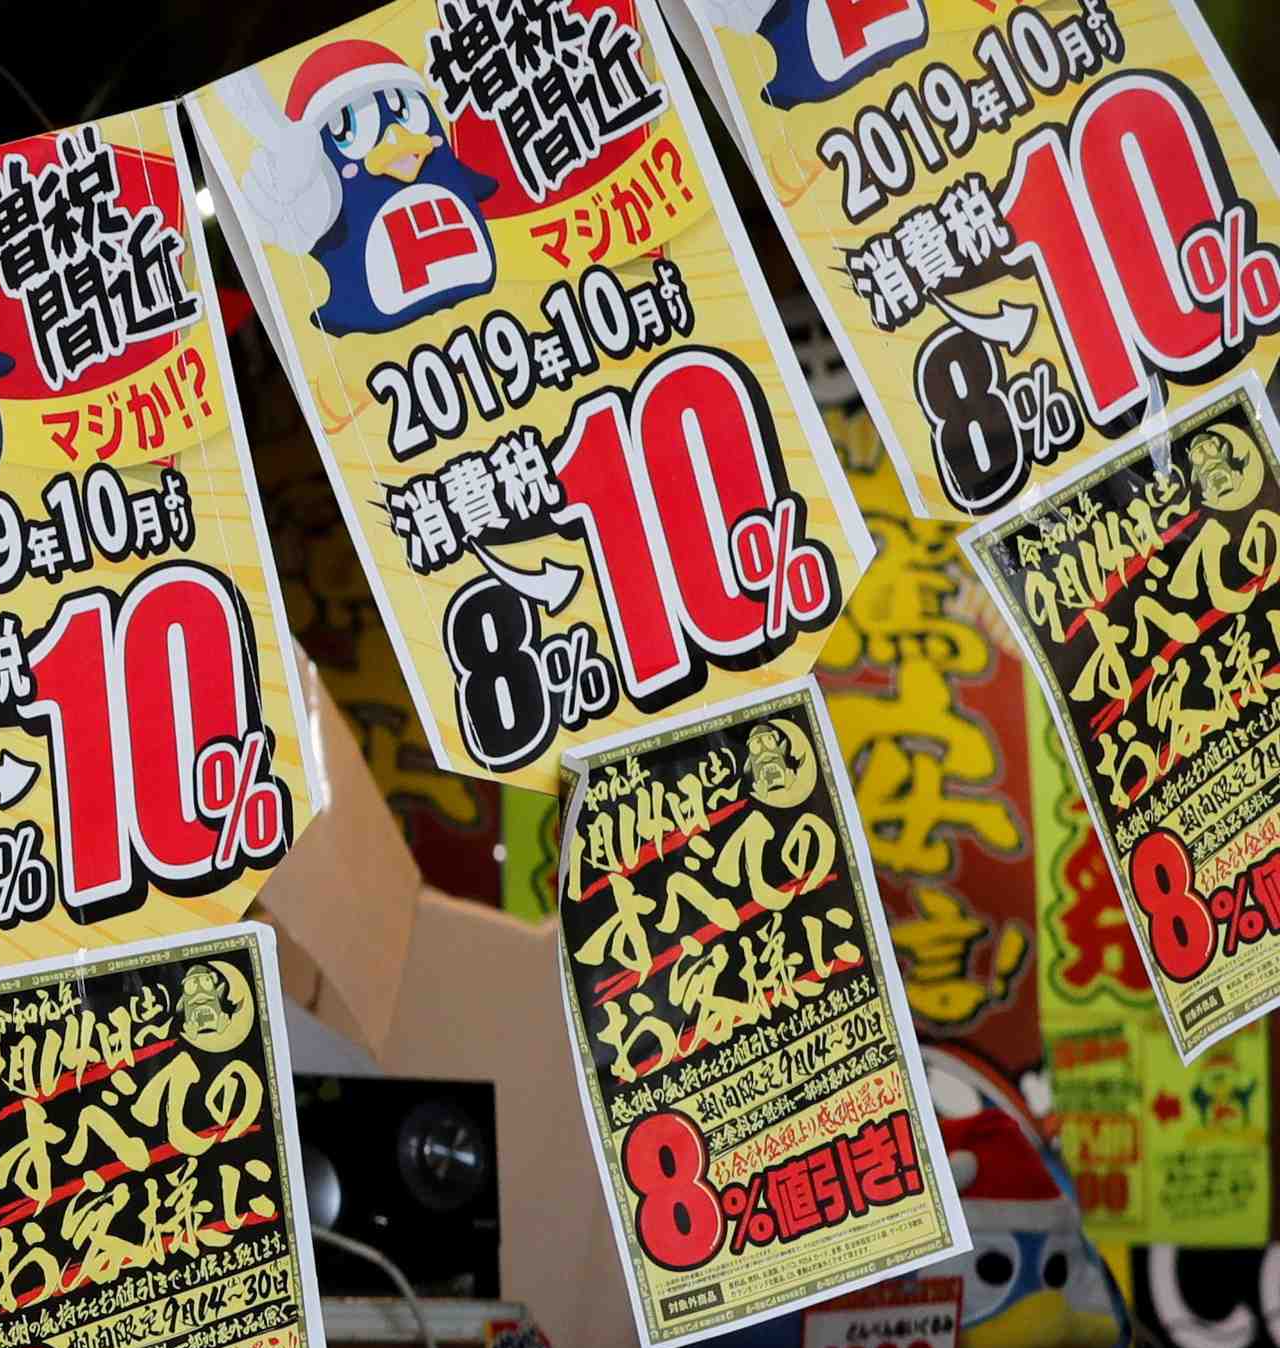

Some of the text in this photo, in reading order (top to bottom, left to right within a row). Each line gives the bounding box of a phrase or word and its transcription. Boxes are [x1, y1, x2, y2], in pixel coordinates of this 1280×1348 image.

[499, 18, 662, 192] 間近
[31, 220, 198, 382] 間近
[851, 178, 1010, 328] 消費税
[1001, 75, 1280, 423] 10%
[390, 431, 559, 569] 消費税
[915, 325, 1080, 509] 8%
[551, 353, 834, 698] 10%
[16, 569, 288, 908] 10%
[445, 576, 615, 767] 8%
[574, 813, 836, 976] すべての
[596, 908, 862, 1082] お客様に
